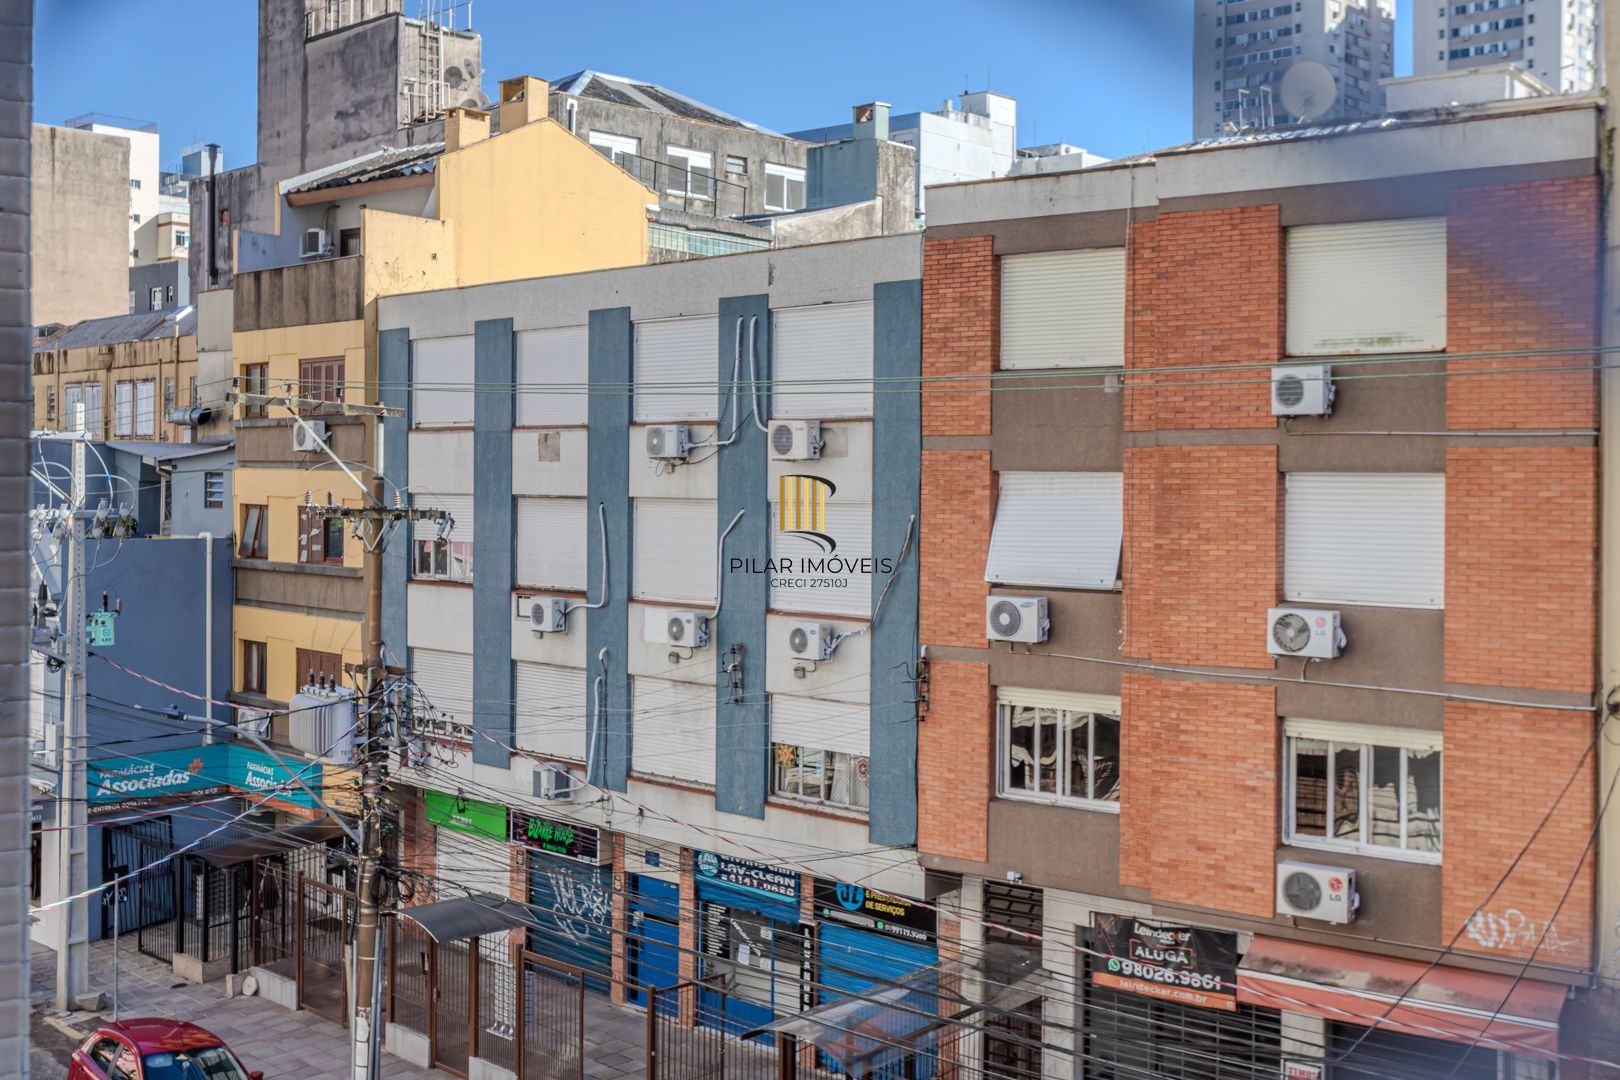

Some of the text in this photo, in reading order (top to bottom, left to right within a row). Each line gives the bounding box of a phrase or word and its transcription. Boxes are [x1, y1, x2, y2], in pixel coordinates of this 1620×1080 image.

[96, 769, 190, 796] Associadas
[720, 862, 795, 887] LAV-CLEAN
[865, 900, 905, 917] DE SERVIÇOS
[1329, 894, 1342, 902] LG
[1134, 922, 1191, 942] Leindecker
[1134, 946, 1189, 964] ALUGA
[1121, 961, 1221, 990] 98026.9861
[1120, 979, 1207, 1004] leindecker.com.br
